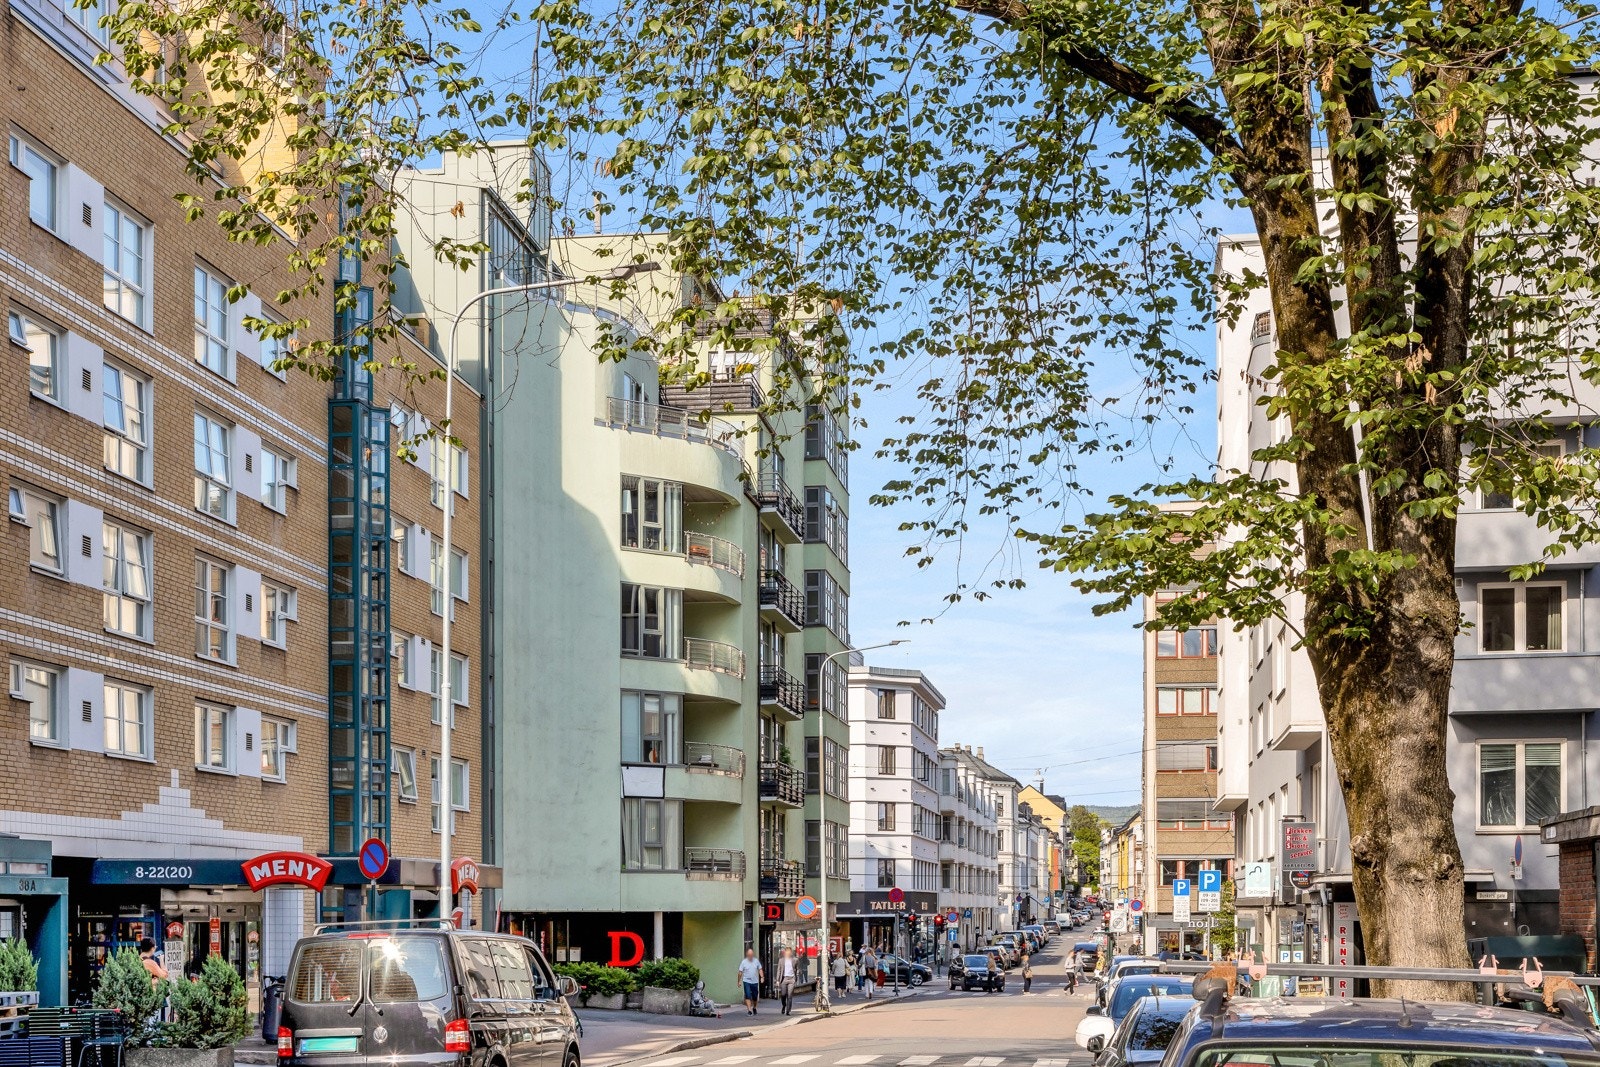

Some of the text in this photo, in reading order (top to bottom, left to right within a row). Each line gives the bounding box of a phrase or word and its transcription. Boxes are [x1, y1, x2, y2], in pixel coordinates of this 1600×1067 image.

[135, 865, 192, 879] 8-22(20)
[251, 859, 322, 882] MENY
[458, 863, 480, 884] MENY
[18, 879, 36, 892] 38A
[1177, 882, 1186, 894] P
[1204, 873, 1216, 890] P
[767, 905, 780, 918] D
[870, 901, 906, 910] TATLER
[607, 931, 645, 967] D
